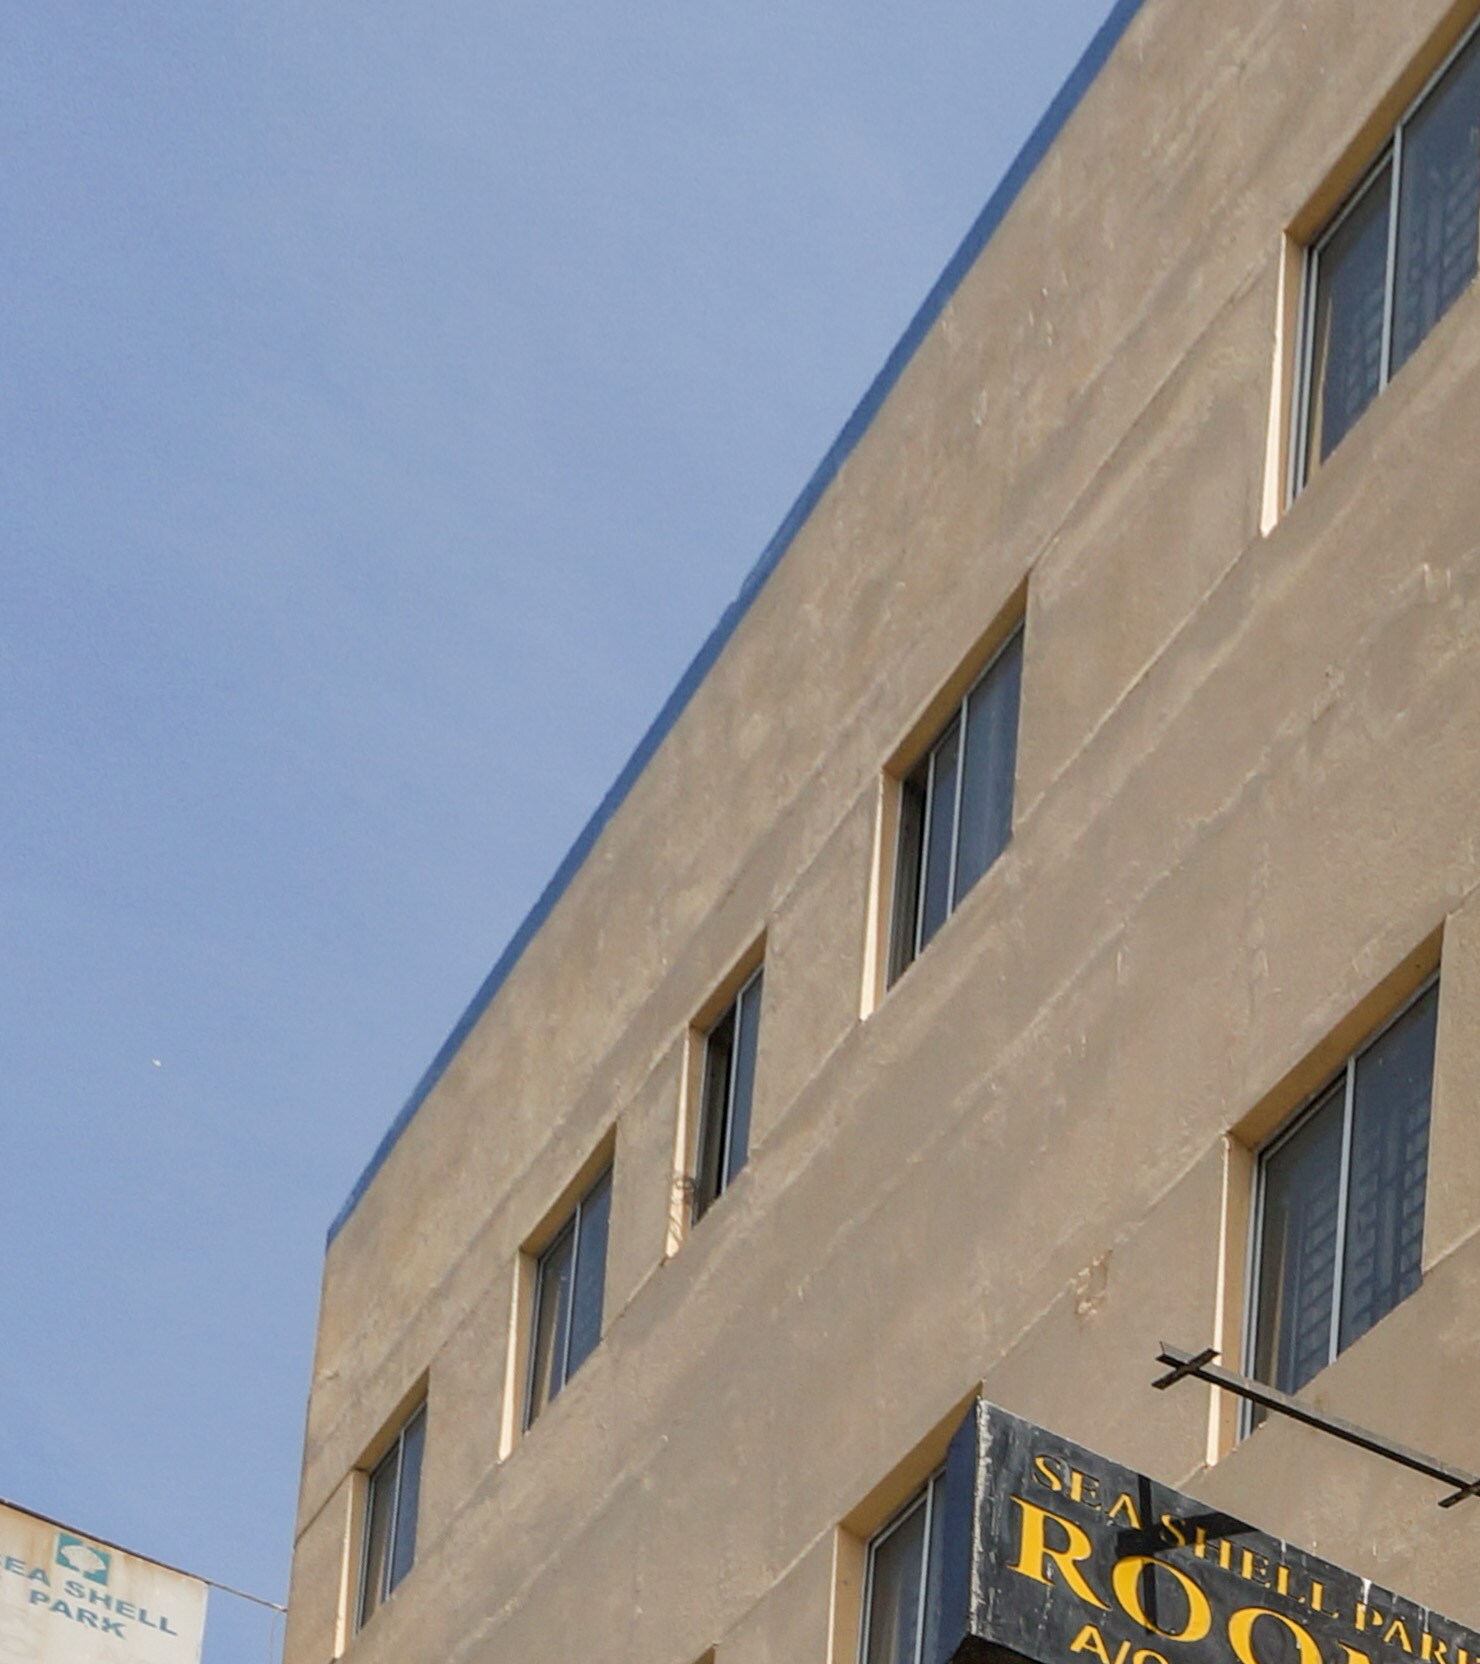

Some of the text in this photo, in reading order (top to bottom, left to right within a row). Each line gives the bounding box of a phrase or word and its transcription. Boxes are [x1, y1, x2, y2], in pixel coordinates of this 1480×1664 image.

[1032, 1455, 1143, 1531] SEA
[1160, 1513, 1340, 1621] SHELL
[0, 1556, 178, 1637] EA SHELL
[28, 1588, 127, 1641] PARK
